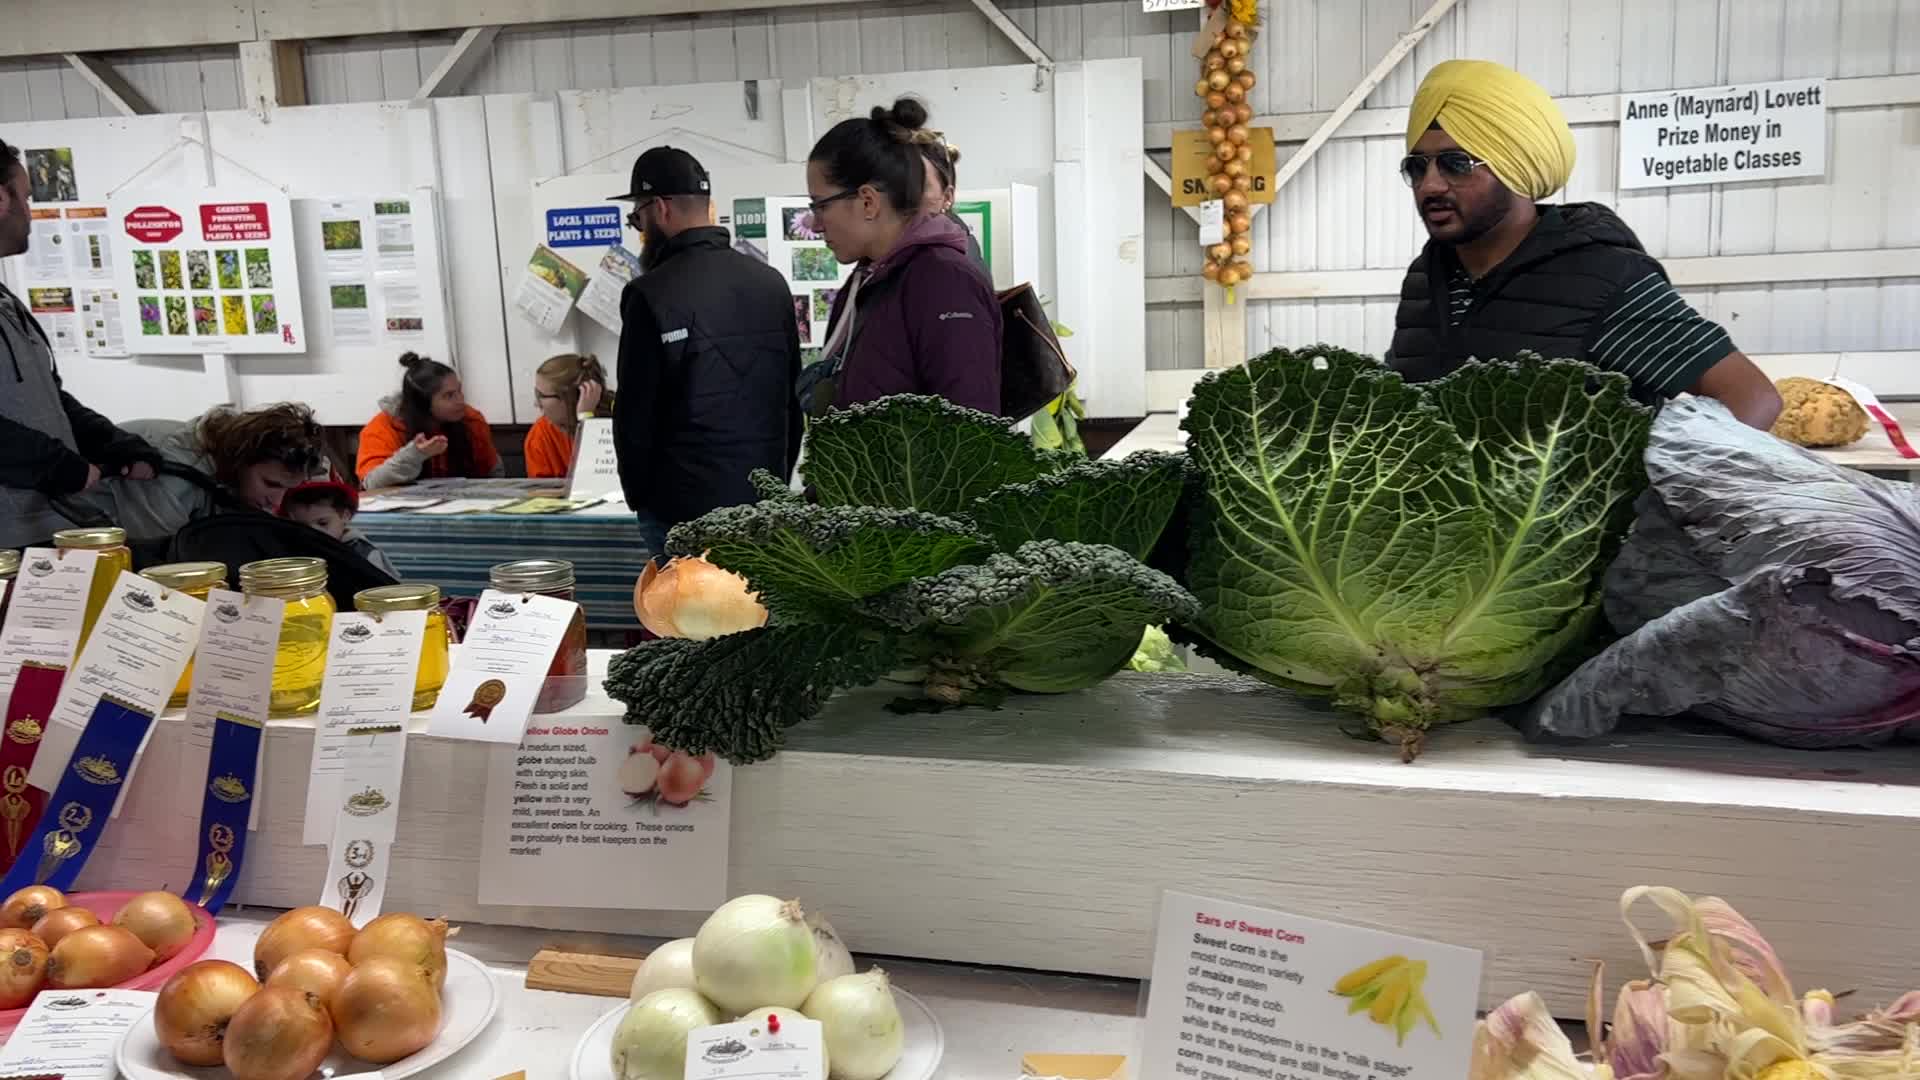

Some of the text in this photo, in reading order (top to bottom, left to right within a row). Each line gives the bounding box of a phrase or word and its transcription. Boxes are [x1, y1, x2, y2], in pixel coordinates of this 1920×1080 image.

[1626, 85, 1821, 121] Anne (Maynard) Lovett
[1657, 119, 1782, 147] Prize Money in
[1642, 149, 1802, 180] Vegetable Classes
[552, 213, 618, 227] LOCAL NATIVE
[549, 228, 621, 241] PLANTS & SEEDS
[526, 727, 609, 735] ellow Globe Onion
[518, 743, 525, 751] A
[517, 756, 597, 766] globe shaped bulb
[535, 769, 567, 779] clinging
[515, 781, 537, 790] Flesh
[549, 782, 569, 790] solid
[571, 782, 588, 790] and
[513, 795, 542, 804] yellow
[544, 795, 562, 803] with
[572, 797, 592, 805] very
[535, 808, 560, 816] sweet
[587, 808, 600, 816] An
[512, 820, 695, 832] excellent onion for cooking. These onions
[526, 835, 563, 844] probably
[566, 834, 579, 843] the
[581, 835, 600, 843] best
[603, 835, 637, 846] keepers
[653, 836, 668, 845] the
[1195, 912, 1305, 944] Ears of Sweet Corn
[1193, 932, 1288, 962] Sweet corn is the
[1188, 965, 1268, 992] of maize eaten
[1190, 950, 1304, 985] most common variety
[1186, 982, 1286, 1014] directly off the cob.
[1186, 996, 1275, 1028] The ear is picked
[1180, 1031, 1193, 1041] so
[1195, 1033, 1216, 1048] that
[1218, 1039, 1235, 1053] the
[1238, 1044, 1277, 1063] kernels
[1280, 1056, 1298, 1068] are
[1300, 1060, 1320, 1074] still
[1182, 1014, 1413, 1078] while the endosperm is in the "milk stage"
[1177, 1047, 1204, 1061] corn
[1206, 1055, 1224, 1067] are
[1226, 1060, 1273, 1079] steamed
